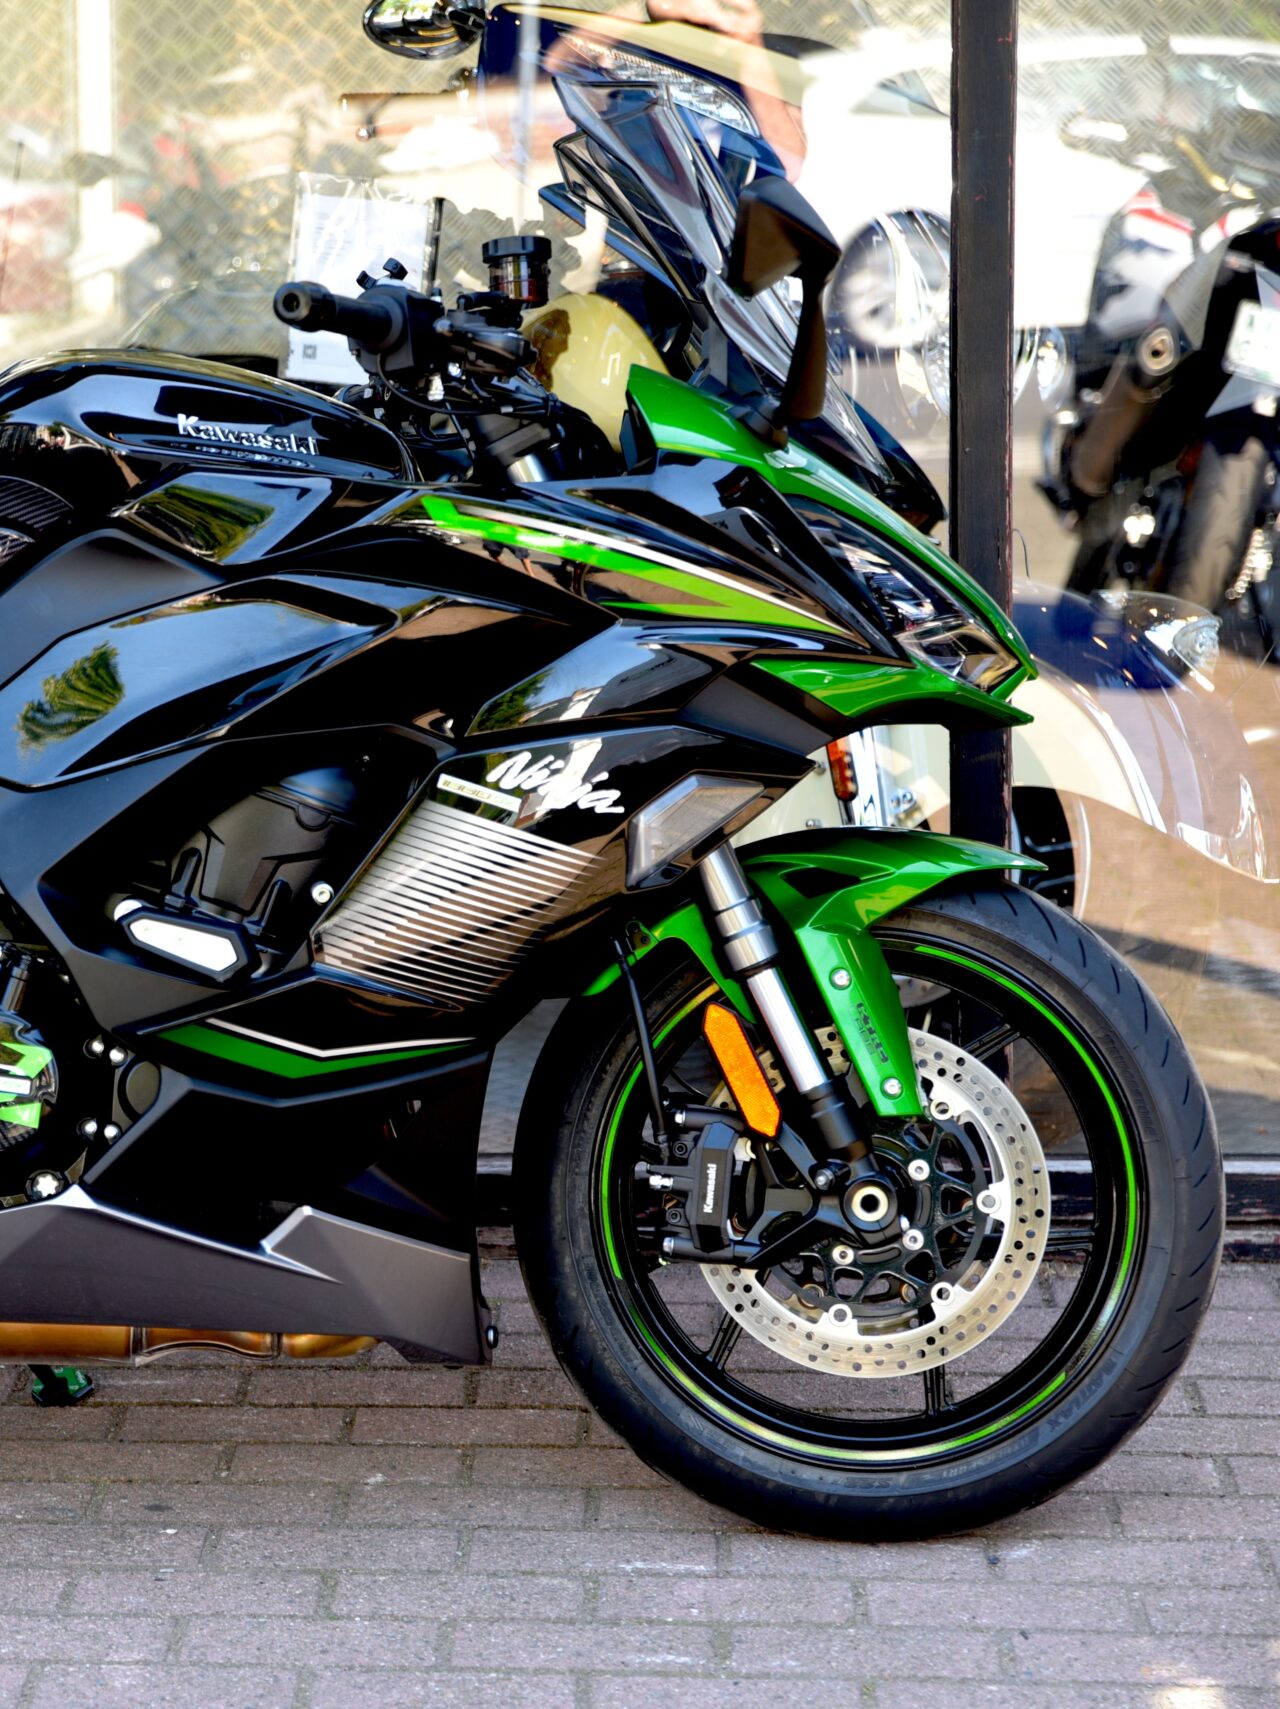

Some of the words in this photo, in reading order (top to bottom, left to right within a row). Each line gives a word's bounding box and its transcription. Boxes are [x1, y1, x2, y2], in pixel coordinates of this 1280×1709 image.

[177, 413, 319, 455] Kawasaki
[486, 751, 625, 813] Ninja
[703, 1163, 718, 1213] Kawasaki
